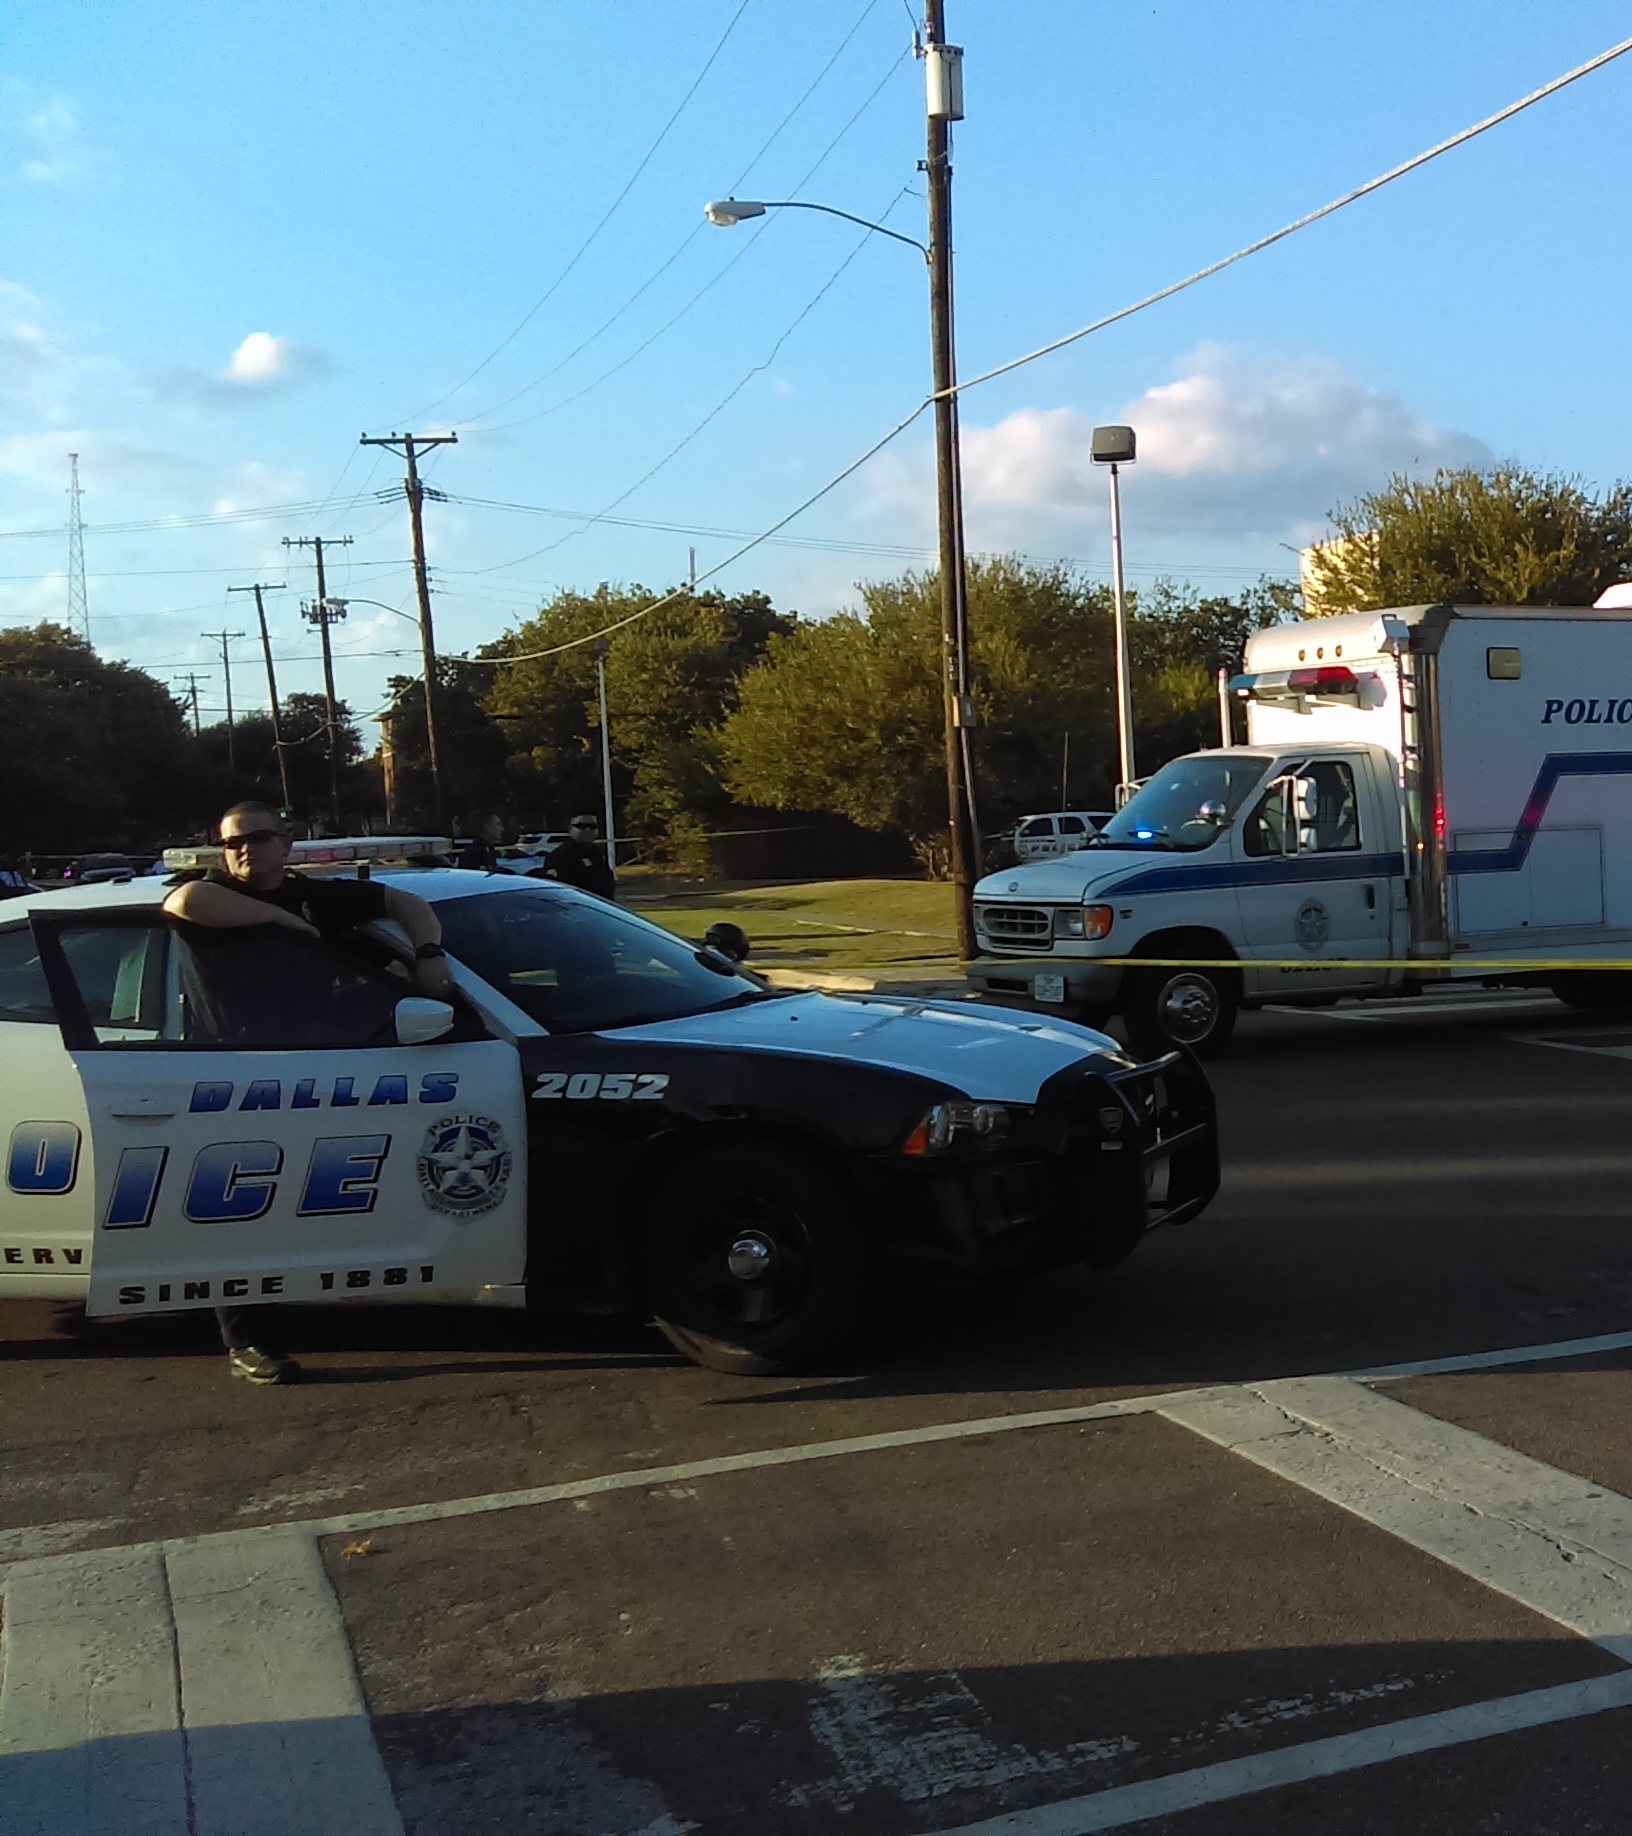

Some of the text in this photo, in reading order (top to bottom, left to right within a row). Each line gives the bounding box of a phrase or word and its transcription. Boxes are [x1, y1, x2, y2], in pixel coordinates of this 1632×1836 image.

[188, 1072, 460, 1113] DALLAS
[531, 1073, 671, 1101] 2052
[428, 1115, 501, 1137] POLICE
[118, 1265, 436, 1304] SINCE 1881
